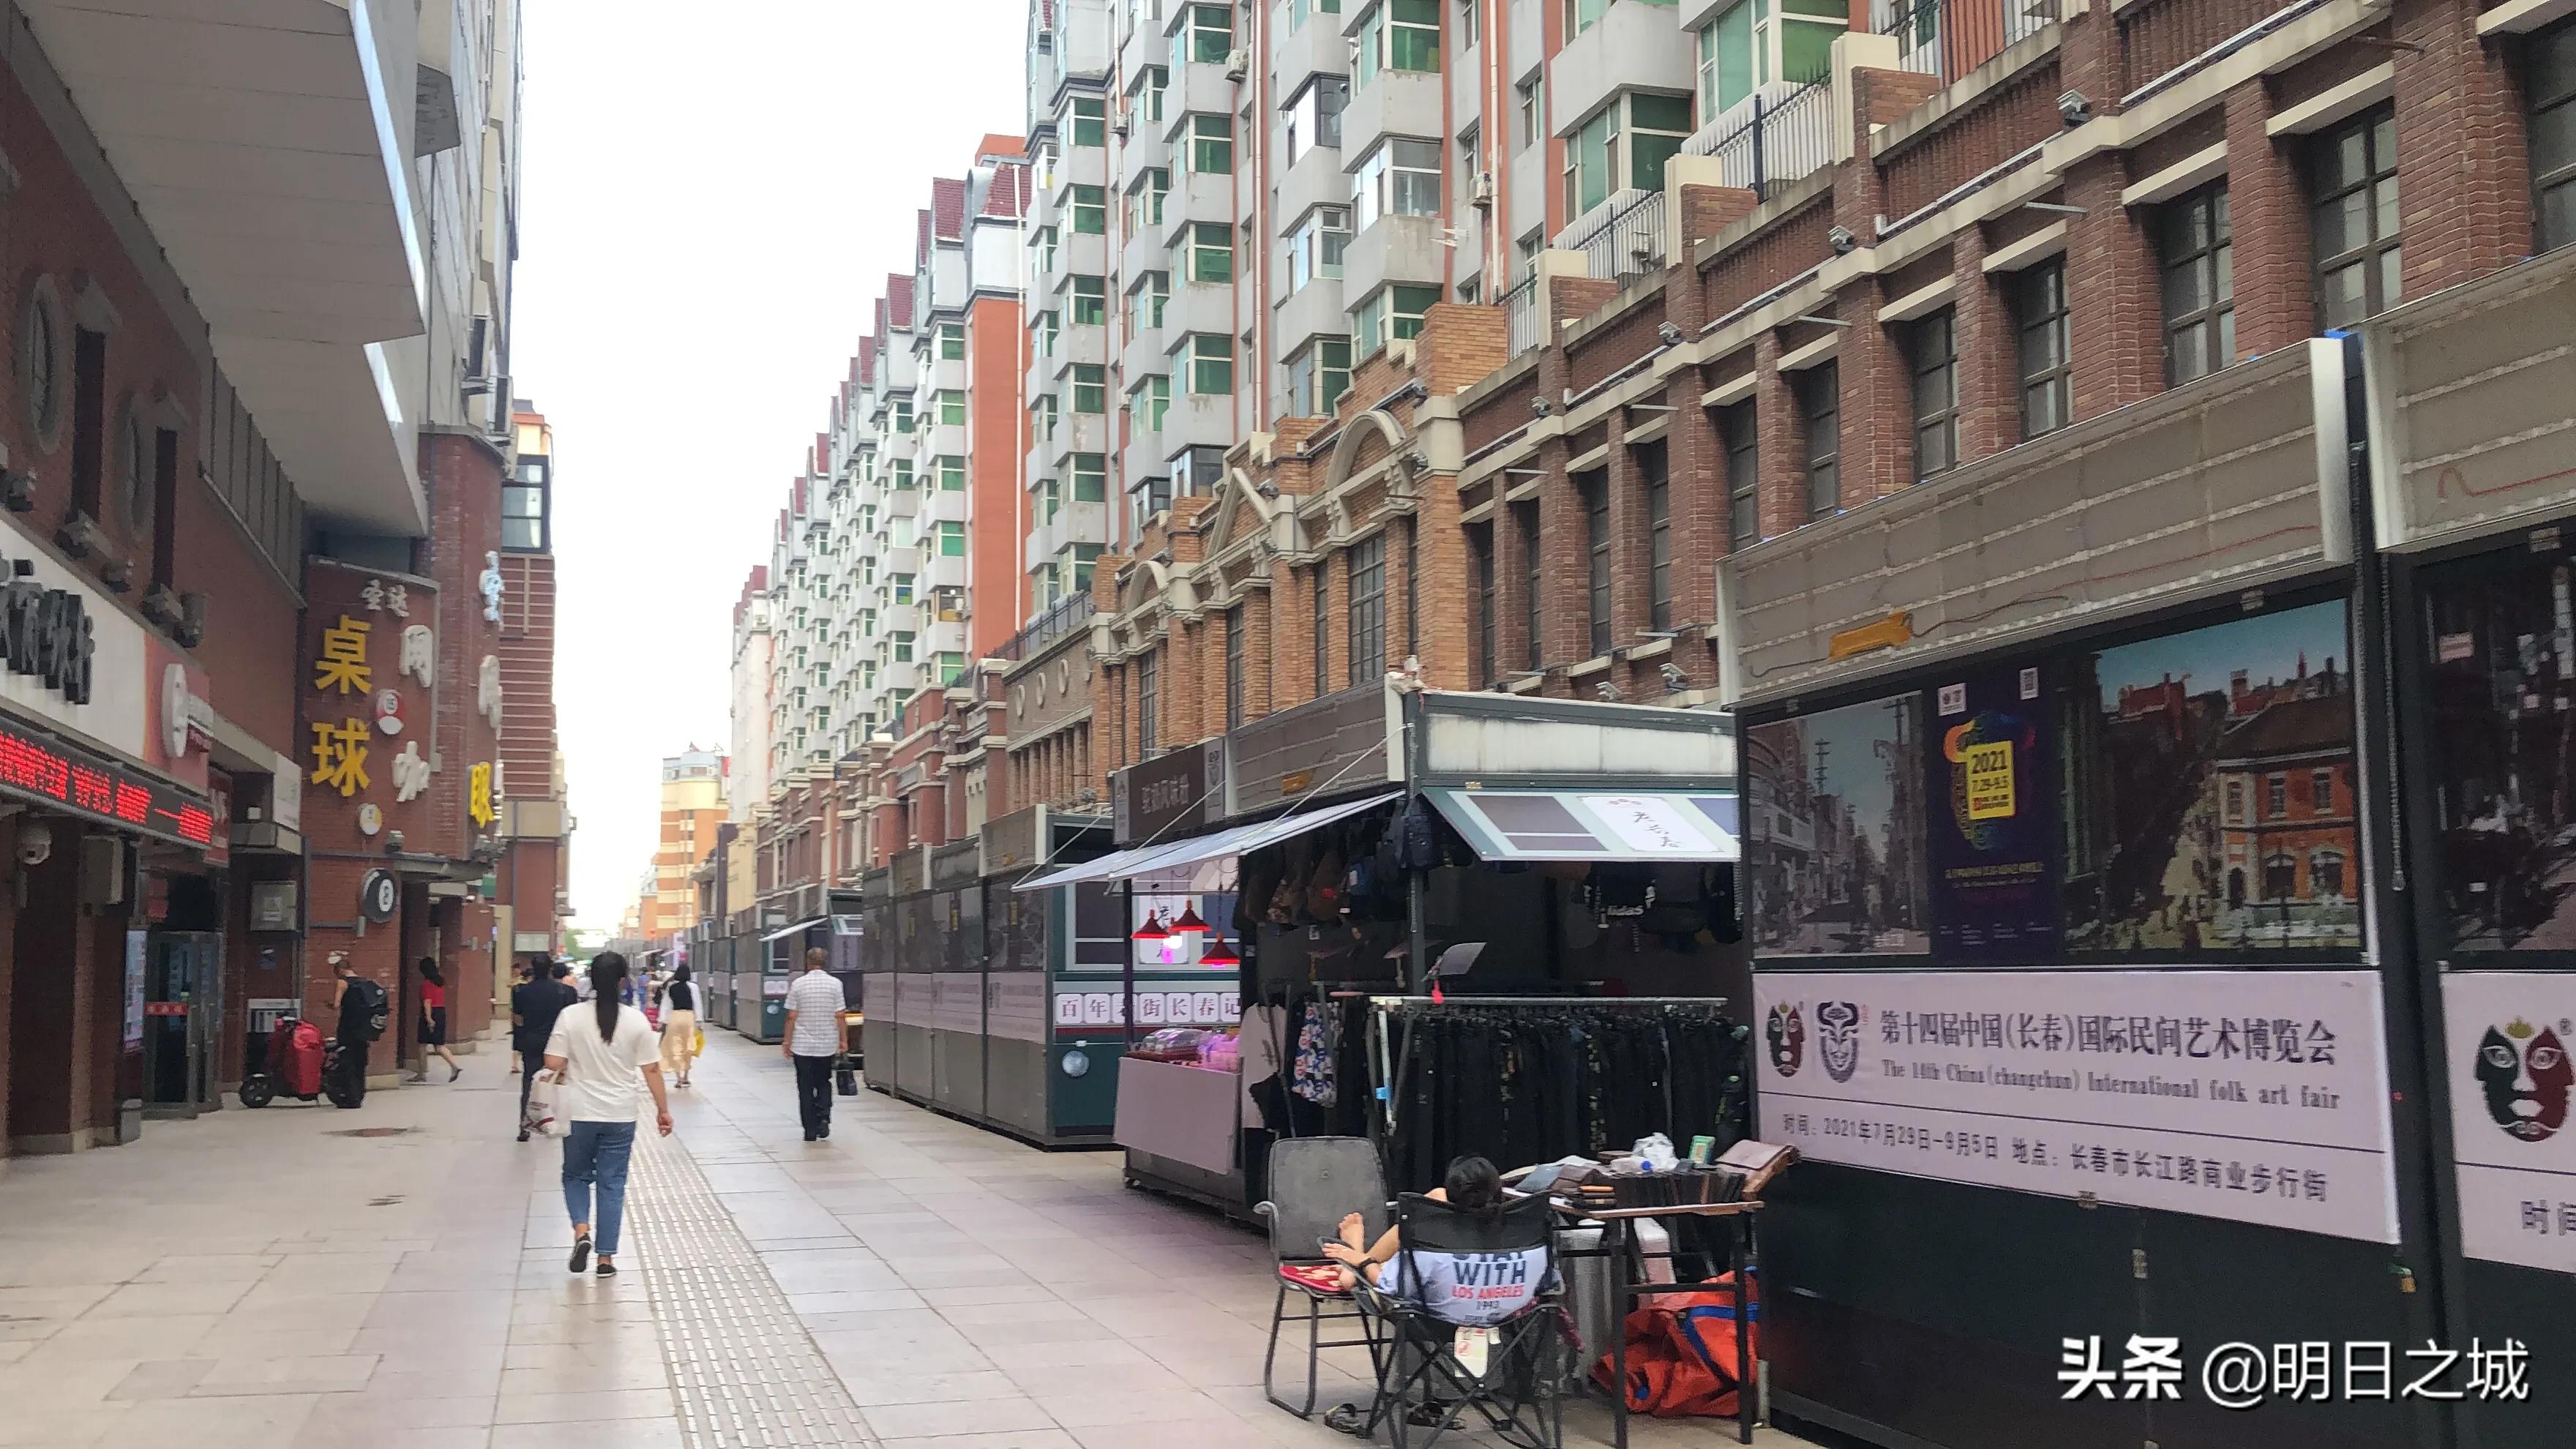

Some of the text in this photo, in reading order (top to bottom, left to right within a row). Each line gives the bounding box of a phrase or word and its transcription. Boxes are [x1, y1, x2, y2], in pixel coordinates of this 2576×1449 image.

[311, 614, 372, 796] 桌球
[1972, 749, 2008, 774] 2021
[1882, 1059, 1906, 1077] The
[2088, 1071, 2199, 1098] International
[2209, 1079, 2248, 1102] folk
[2258, 1084, 2290, 1105] art
[2300, 1085, 2340, 1109] fair
[1453, 1259, 1527, 1287] WITH
[1451, 1285, 1524, 1300] LOS ANGELES
